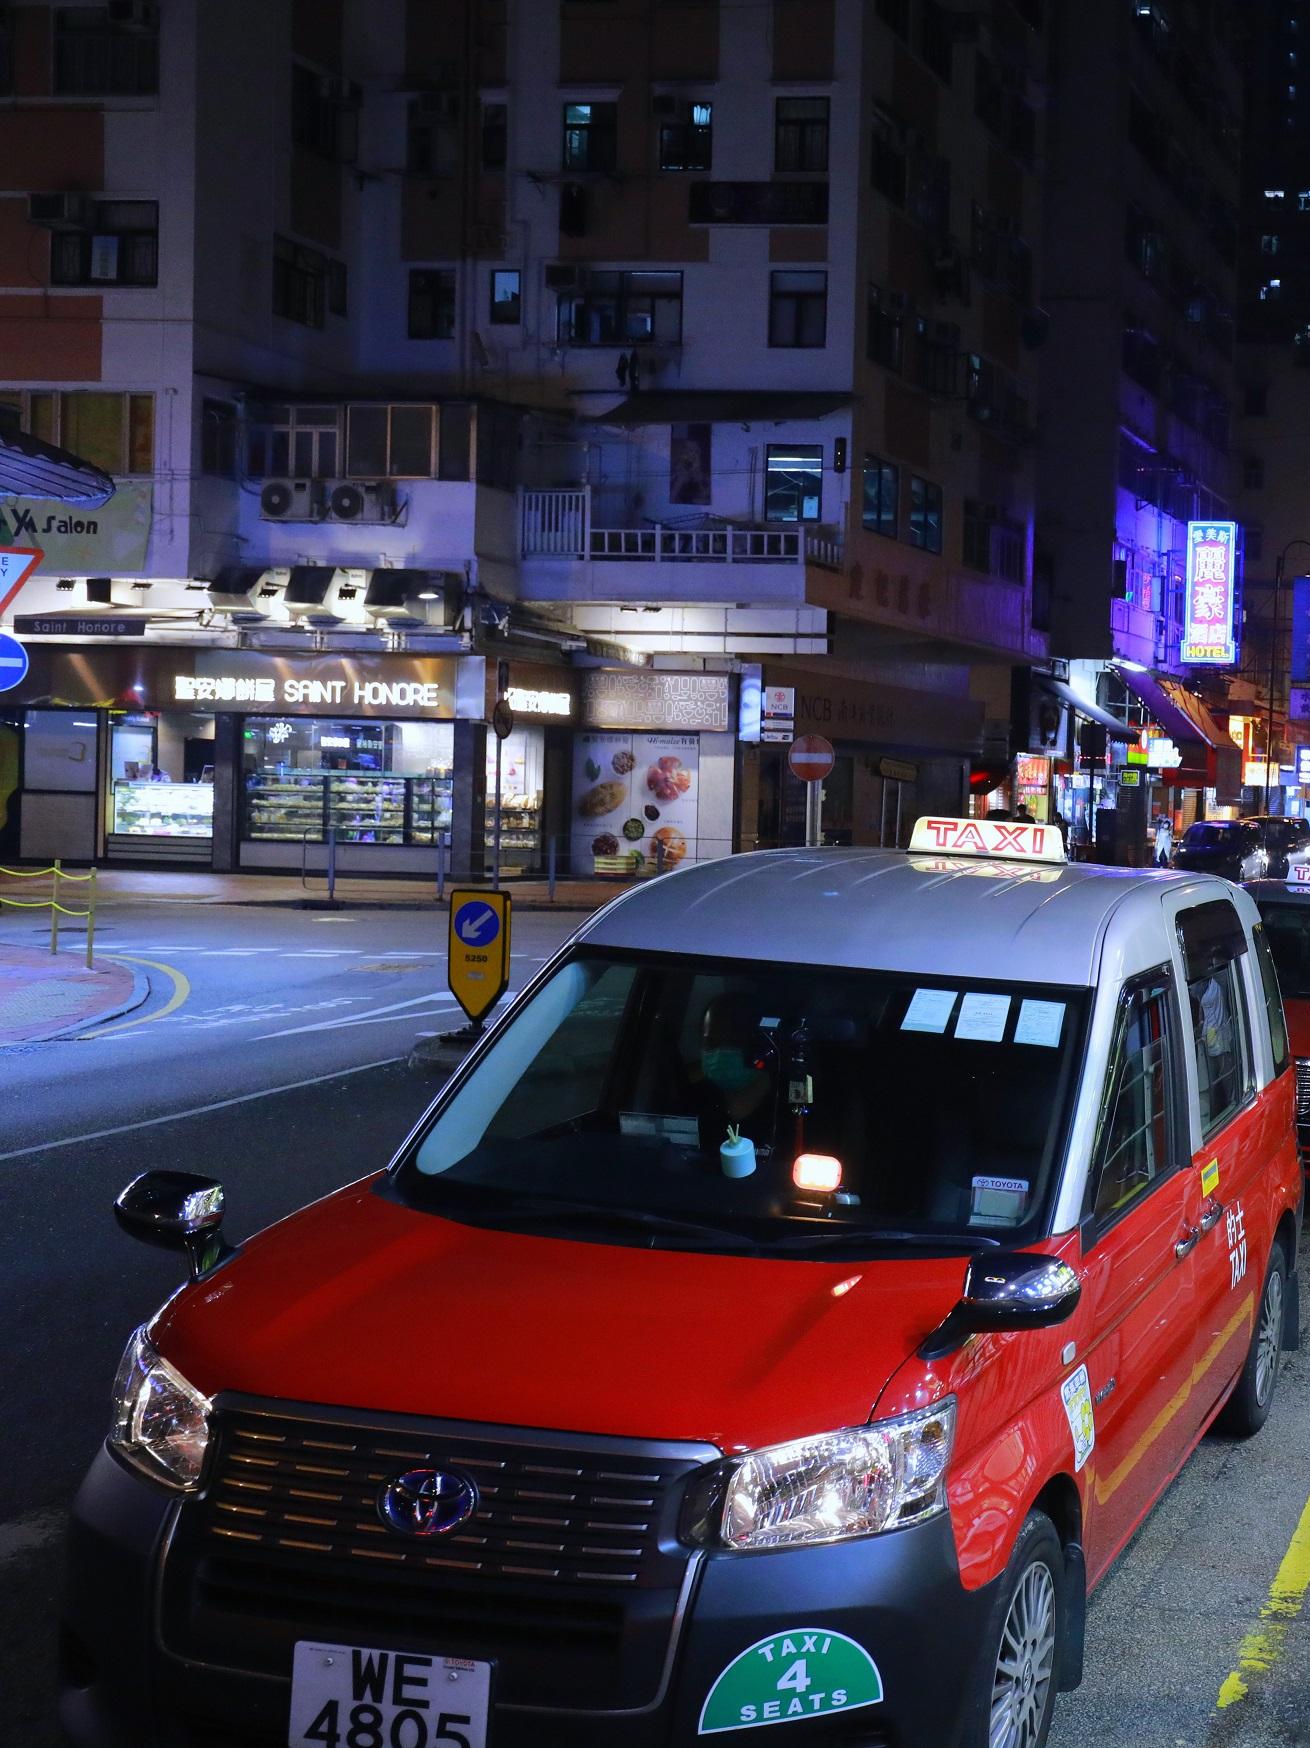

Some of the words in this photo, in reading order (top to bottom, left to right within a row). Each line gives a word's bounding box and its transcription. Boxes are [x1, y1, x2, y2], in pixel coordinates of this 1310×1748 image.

[42, 515, 98, 534] Salon
[34, 621, 67, 633] Saint
[77, 620, 126, 633] Honore
[1186, 645, 1230, 658] HOTEL
[283, 679, 347, 704] SAINT
[353, 682, 439, 708] HONORE
[801, 696, 832, 721] NCB
[927, 820, 1045, 854] TAXI
[991, 1180, 1024, 1190] TOYOTA
[1226, 1200, 1246, 1250] 的士
[1229, 1238, 1248, 1291] TAXI
[758, 1635, 832, 1663] TAXI
[352, 1649, 433, 1709] WE
[776, 1658, 812, 1693] 4
[740, 1689, 848, 1722] SEATS
[303, 1700, 472, 1748] 4805
